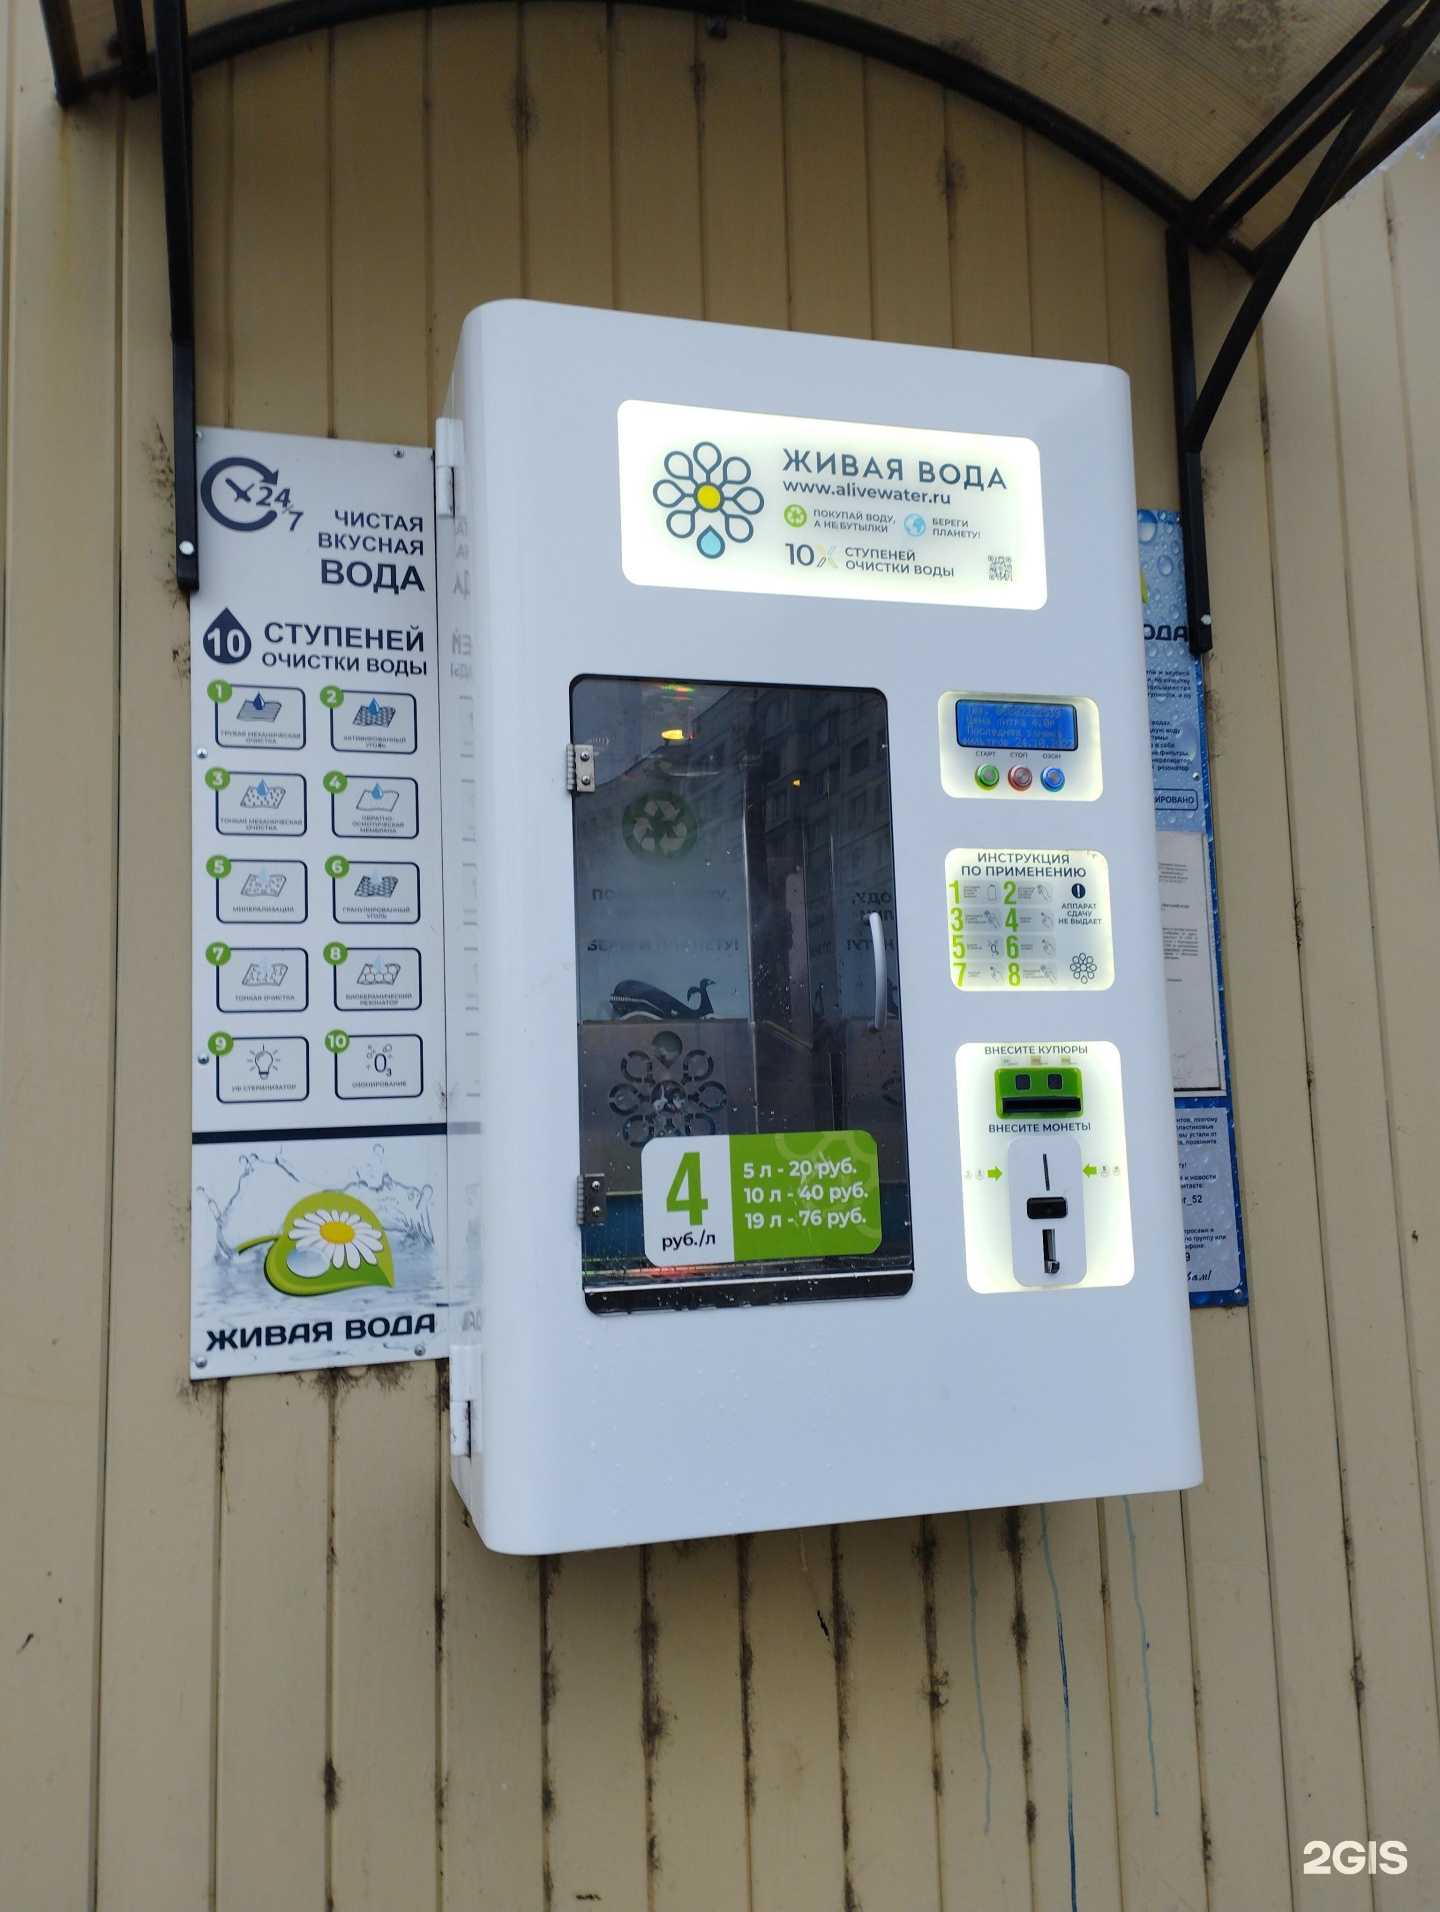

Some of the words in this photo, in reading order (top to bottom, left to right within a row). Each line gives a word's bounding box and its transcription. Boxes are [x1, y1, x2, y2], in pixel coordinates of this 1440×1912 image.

[783, 448, 904, 481] ЖИВАЯ
[918, 460, 1008, 491] ВОДА
[783, 480, 951, 504] www.alivewater.ru
[334, 509, 423, 532] ЧИСТАЯ
[813, 508, 863, 521] ПОКУПАЙ
[865, 514, 896, 525] ВОДУ,
[932, 517, 969, 528] БЕРЕГИ
[840, 523, 889, 533] БУТЫЛКИ
[932, 528, 981, 539] ПЛАНЕТУ!
[318, 532, 424, 555] ВКУСНАЯ
[845, 546, 916, 561] СТУПЕНЕЙ
[785, 542, 815, 567] 10
[321, 559, 425, 595] ВОДА
[845, 560, 910, 574] ОЧИСТКИ
[914, 563, 955, 578] ВОДЫ
[207, 628, 246, 658] 10
[264, 622, 424, 652] СТУПЕНЕЙ
[262, 652, 360, 673] ОЧИСТКИ
[366, 656, 427, 677] ВОДЫ
[215, 685, 224, 698] 1
[327, 690, 337, 704] 2
[213, 772, 223, 785] 3
[329, 776, 340, 789] 4
[213, 860, 224, 873] 5
[331, 860, 342, 873] 6
[977, 852, 1070, 865] ИНСТРУКЦИЯ
[961, 866, 981, 876] ПО
[985, 866, 1087, 877] ПРИМЕНЕНИЮ
[949, 880, 960, 904] 1
[1003, 880, 1017, 905] 2
[950, 907, 964, 931] 3
[1004, 908, 1018, 932] 4
[1067, 910, 1092, 918] СДАЧУ
[213, 948, 223, 960] 7
[330, 947, 340, 960] 8
[952, 935, 965, 959] 5
[1006, 935, 1019, 959] 6
[953, 962, 967, 986] 7
[1008, 963, 1021, 987] 8
[215, 1037, 226, 1050] 9
[327, 1035, 346, 1048] 10
[984, 1046, 1036, 1055] ВНЕСИТЕ
[1038, 1045, 1088, 1055] КУПЮРЫ
[988, 1123, 1040, 1133] ВНЕСИТЕ
[1042, 1122, 1091, 1132] МОНЕТЫ
[743, 1163, 755, 1179] 5
[759, 1164, 772, 1178] л
[789, 1160, 813, 1177] 20
[817, 1157, 857, 1178] руб.
[665, 1151, 709, 1226] 4
[744, 1187, 764, 1203] 10
[769, 1189, 781, 1202] л
[797, 1185, 824, 1201] 40
[829, 1182, 869, 1203] руб.
[744, 1213, 765, 1229] 19
[769, 1214, 782, 1227] л
[799, 1210, 822, 1226] 76
[827, 1207, 867, 1228] руб.
[662, 1230, 716, 1251] руб./л
[206, 1321, 333, 1352] ЖИВАЯ
[346, 1313, 436, 1340] ВОДА
